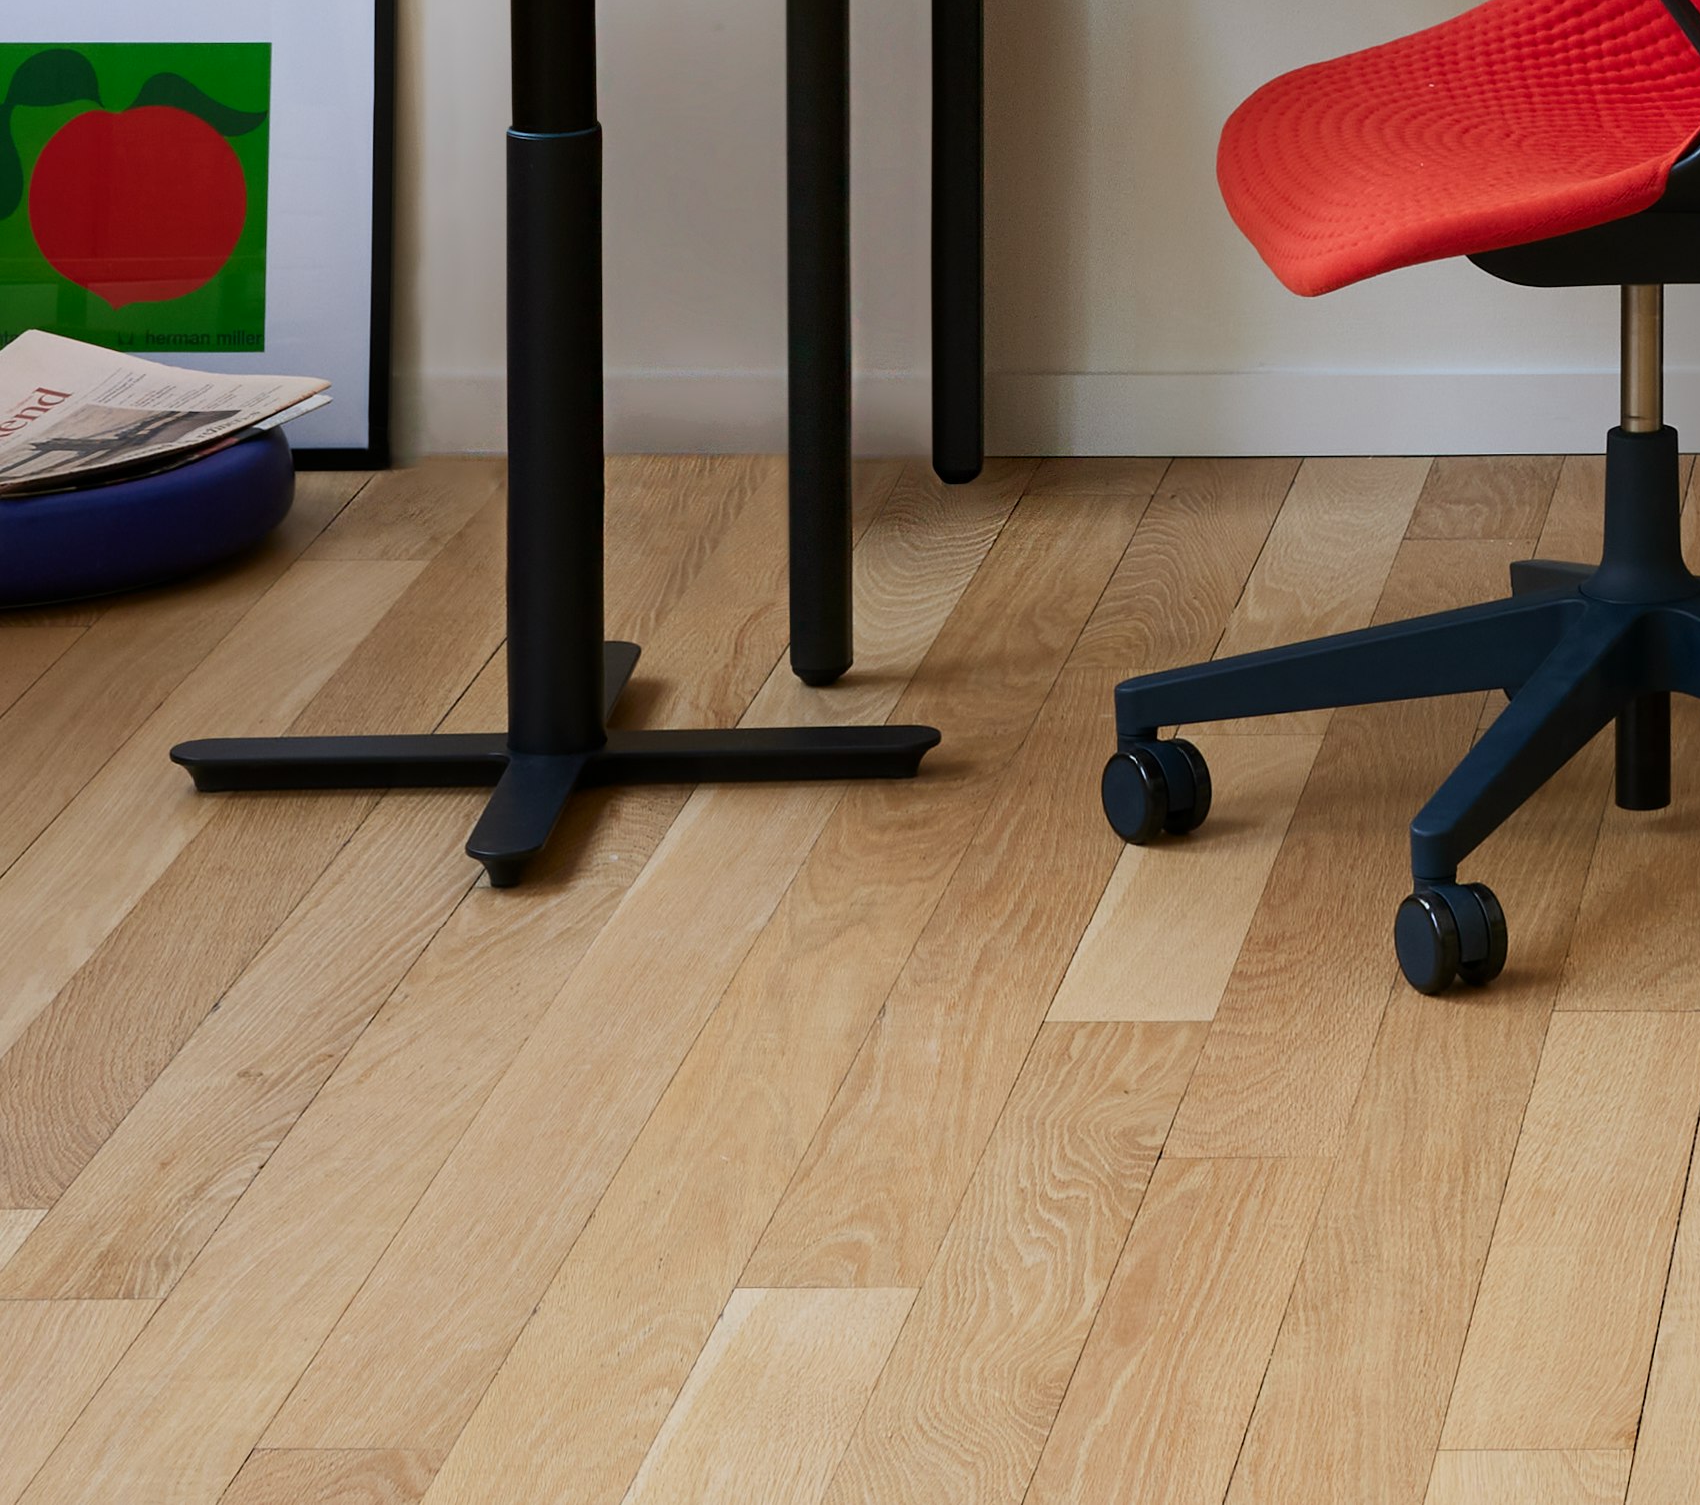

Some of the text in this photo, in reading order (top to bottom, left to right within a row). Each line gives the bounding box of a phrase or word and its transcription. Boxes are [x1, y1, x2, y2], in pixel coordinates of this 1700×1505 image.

[145, 329, 263, 346] herman miller
[0, 387, 73, 438] end
